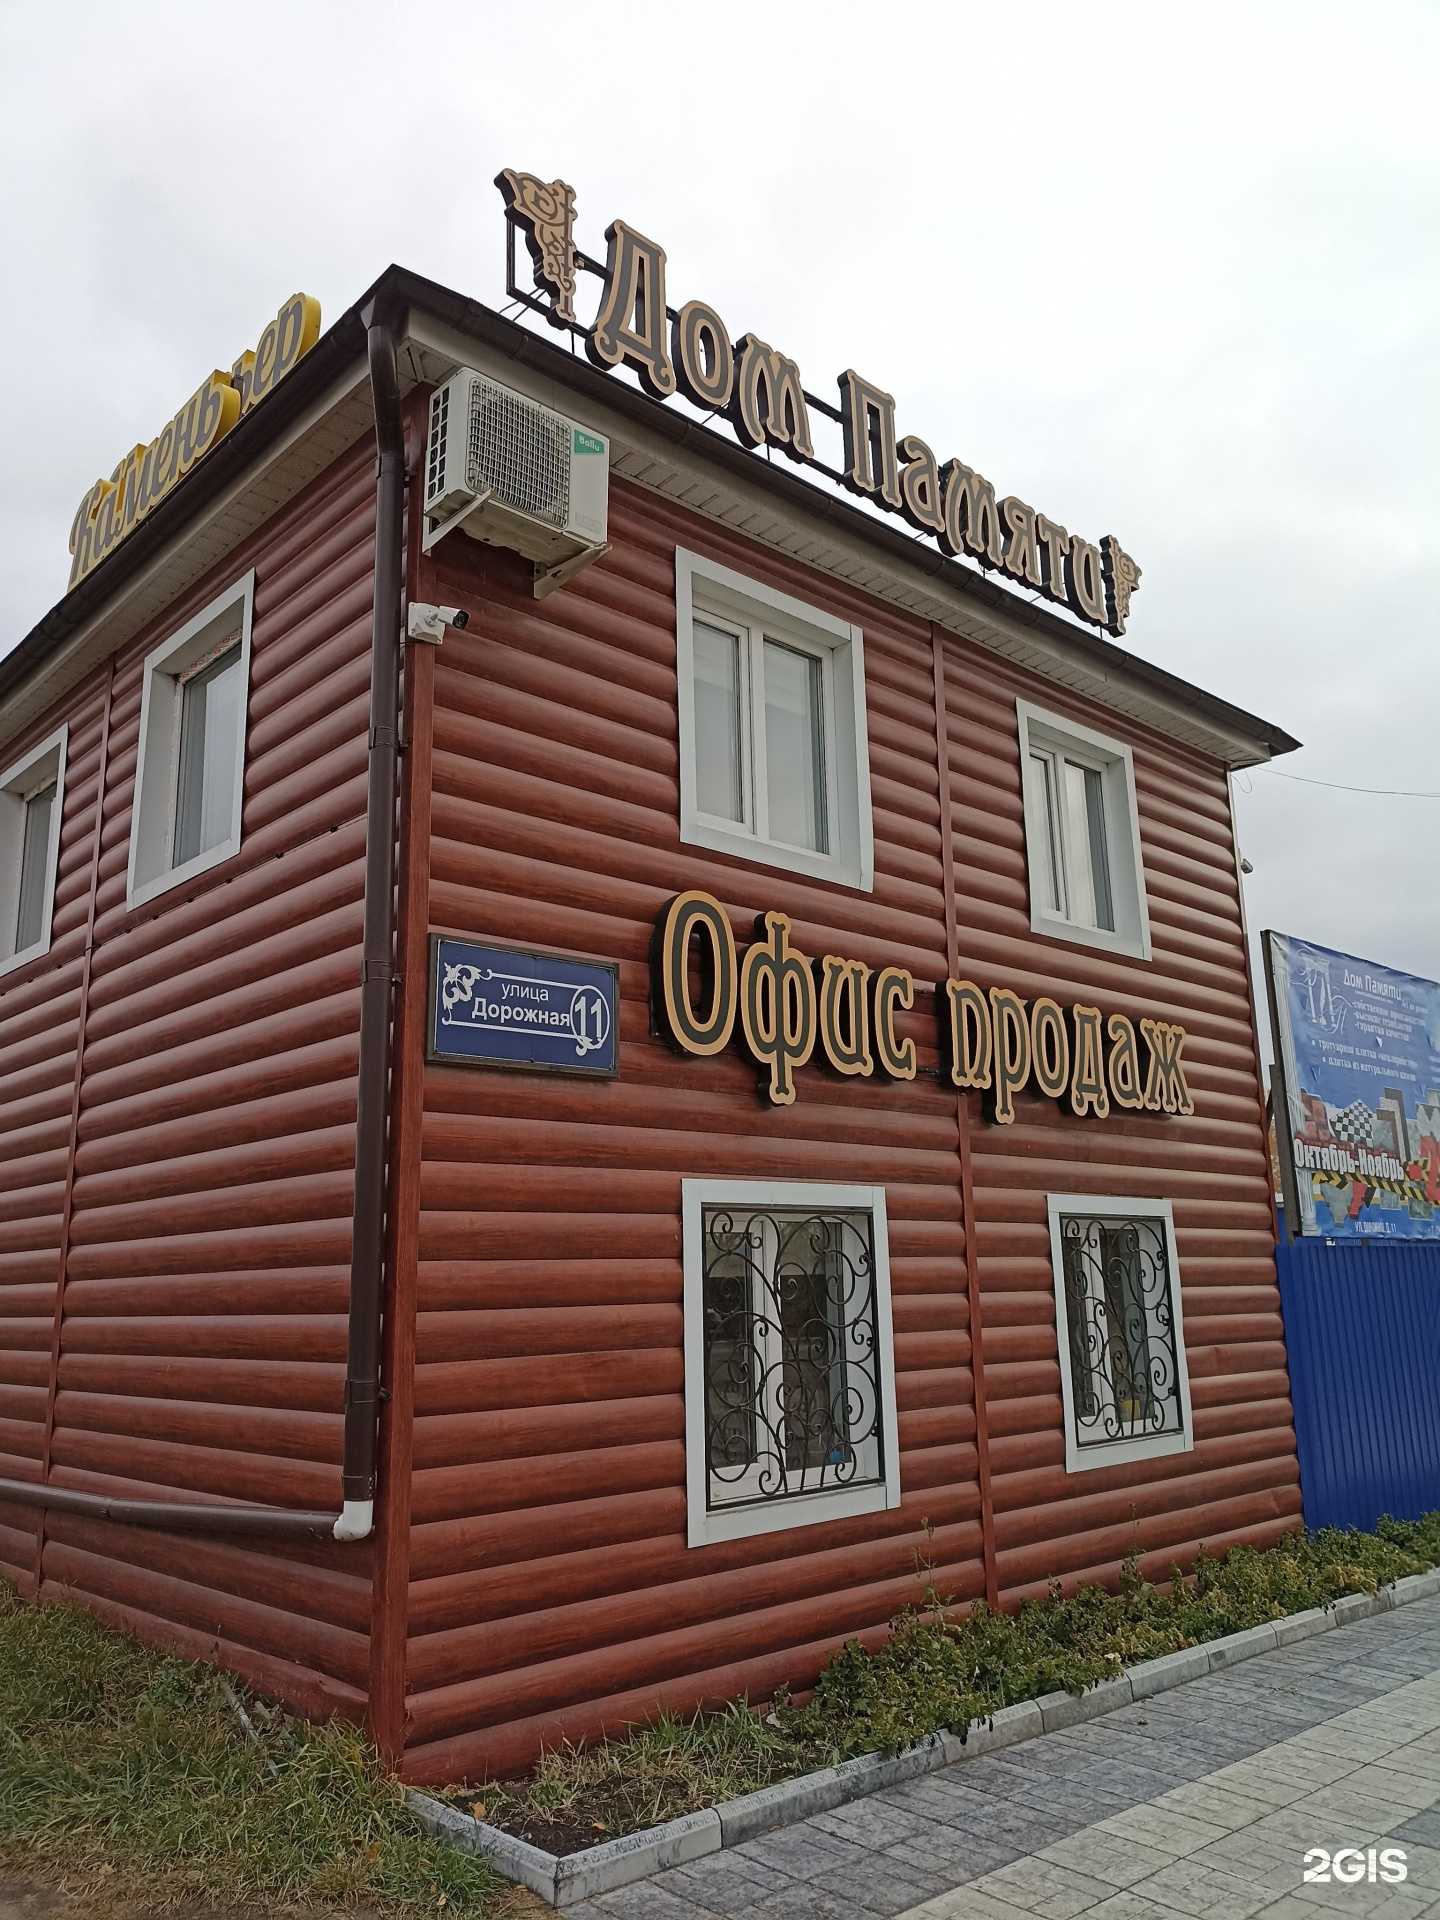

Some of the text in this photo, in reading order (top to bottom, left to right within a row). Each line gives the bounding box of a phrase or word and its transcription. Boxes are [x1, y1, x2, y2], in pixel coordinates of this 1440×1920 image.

[585, 220, 1108, 624] Дом Памяти
[471, 995, 602, 1042] Дорожная 11
[501, 982, 550, 1003] улица
[656, 889, 1195, 1125] Офис продаж
